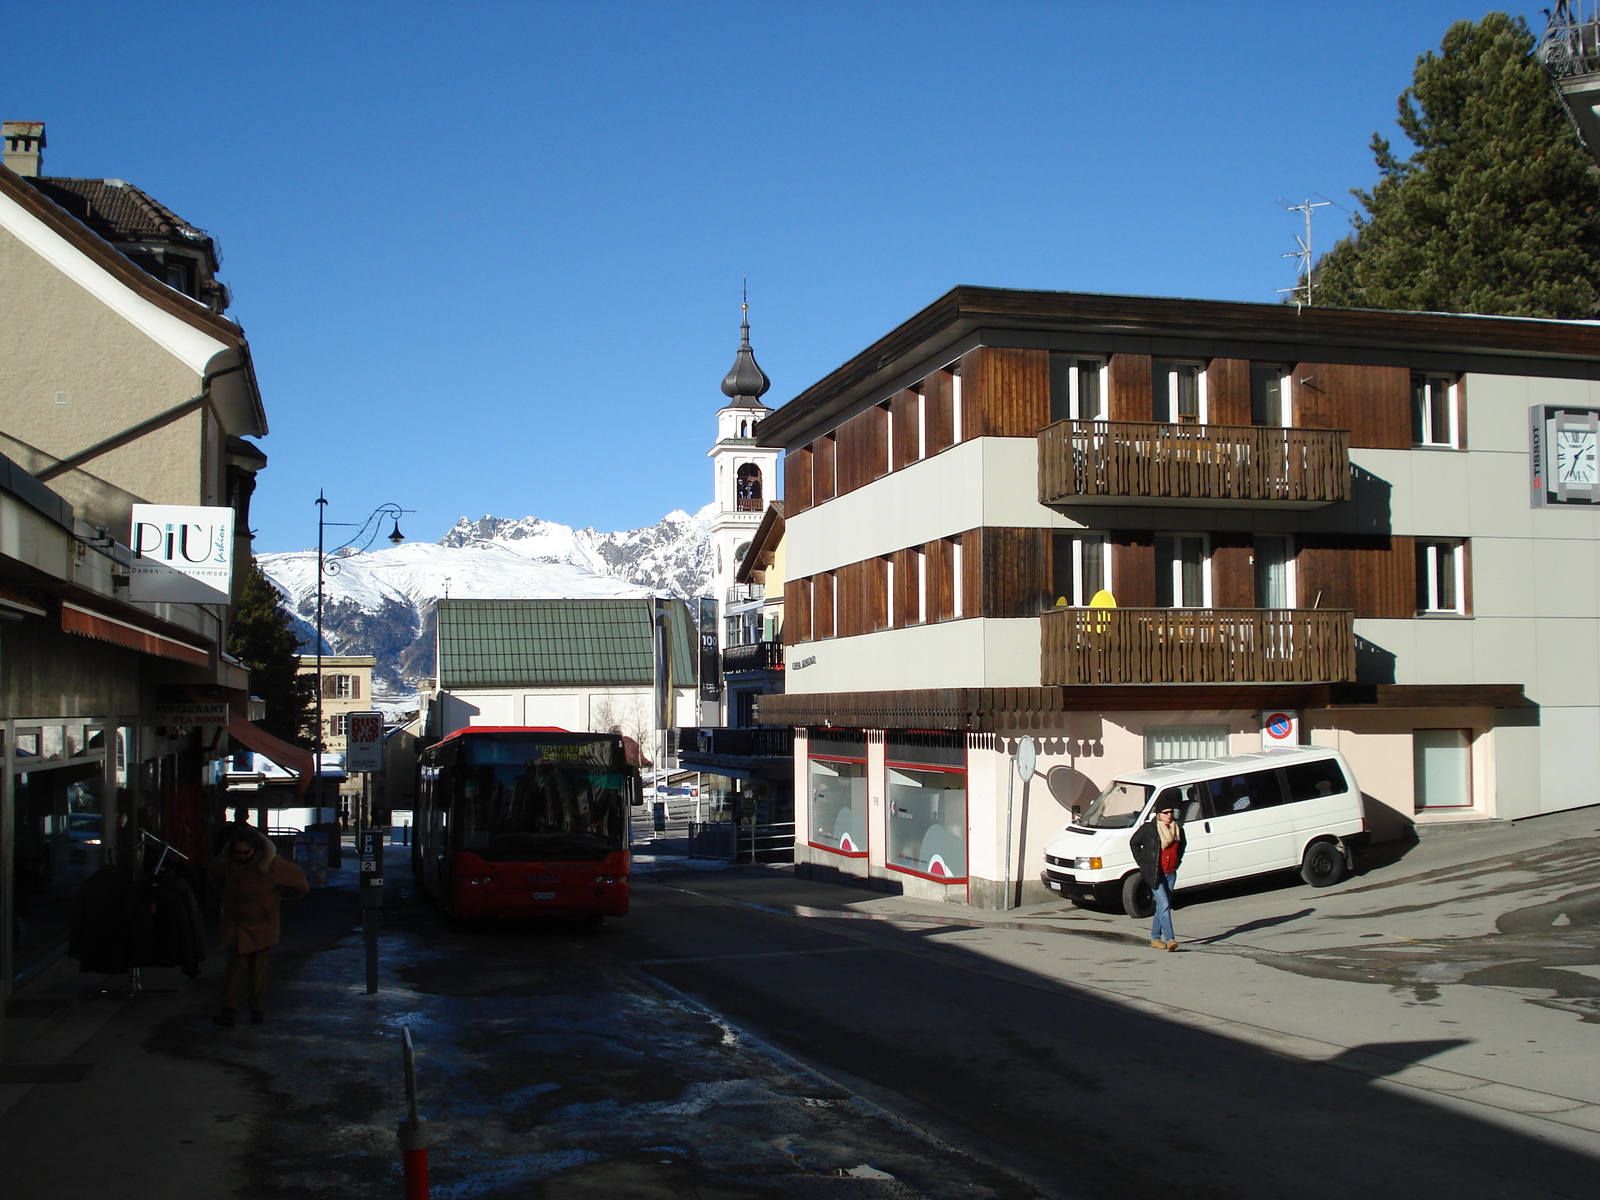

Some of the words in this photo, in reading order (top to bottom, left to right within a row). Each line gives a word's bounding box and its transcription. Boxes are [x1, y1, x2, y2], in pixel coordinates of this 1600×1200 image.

[213, 524, 227, 564] fashion
[132, 567, 163, 575] Damen-
[177, 569, 228, 577] Herrenmode
[702, 635, 718, 647] 100
[155, 705, 225, 714] RESTAURANT
[172, 716, 193, 724] TEA
[195, 716, 225, 724] ROOM
[351, 717, 379, 732] BUS
[351, 731, 379, 744] STOP
[543, 752, 582, 762] Bahnhof
[365, 835, 373, 845] P
[365, 862, 372, 871] 2
